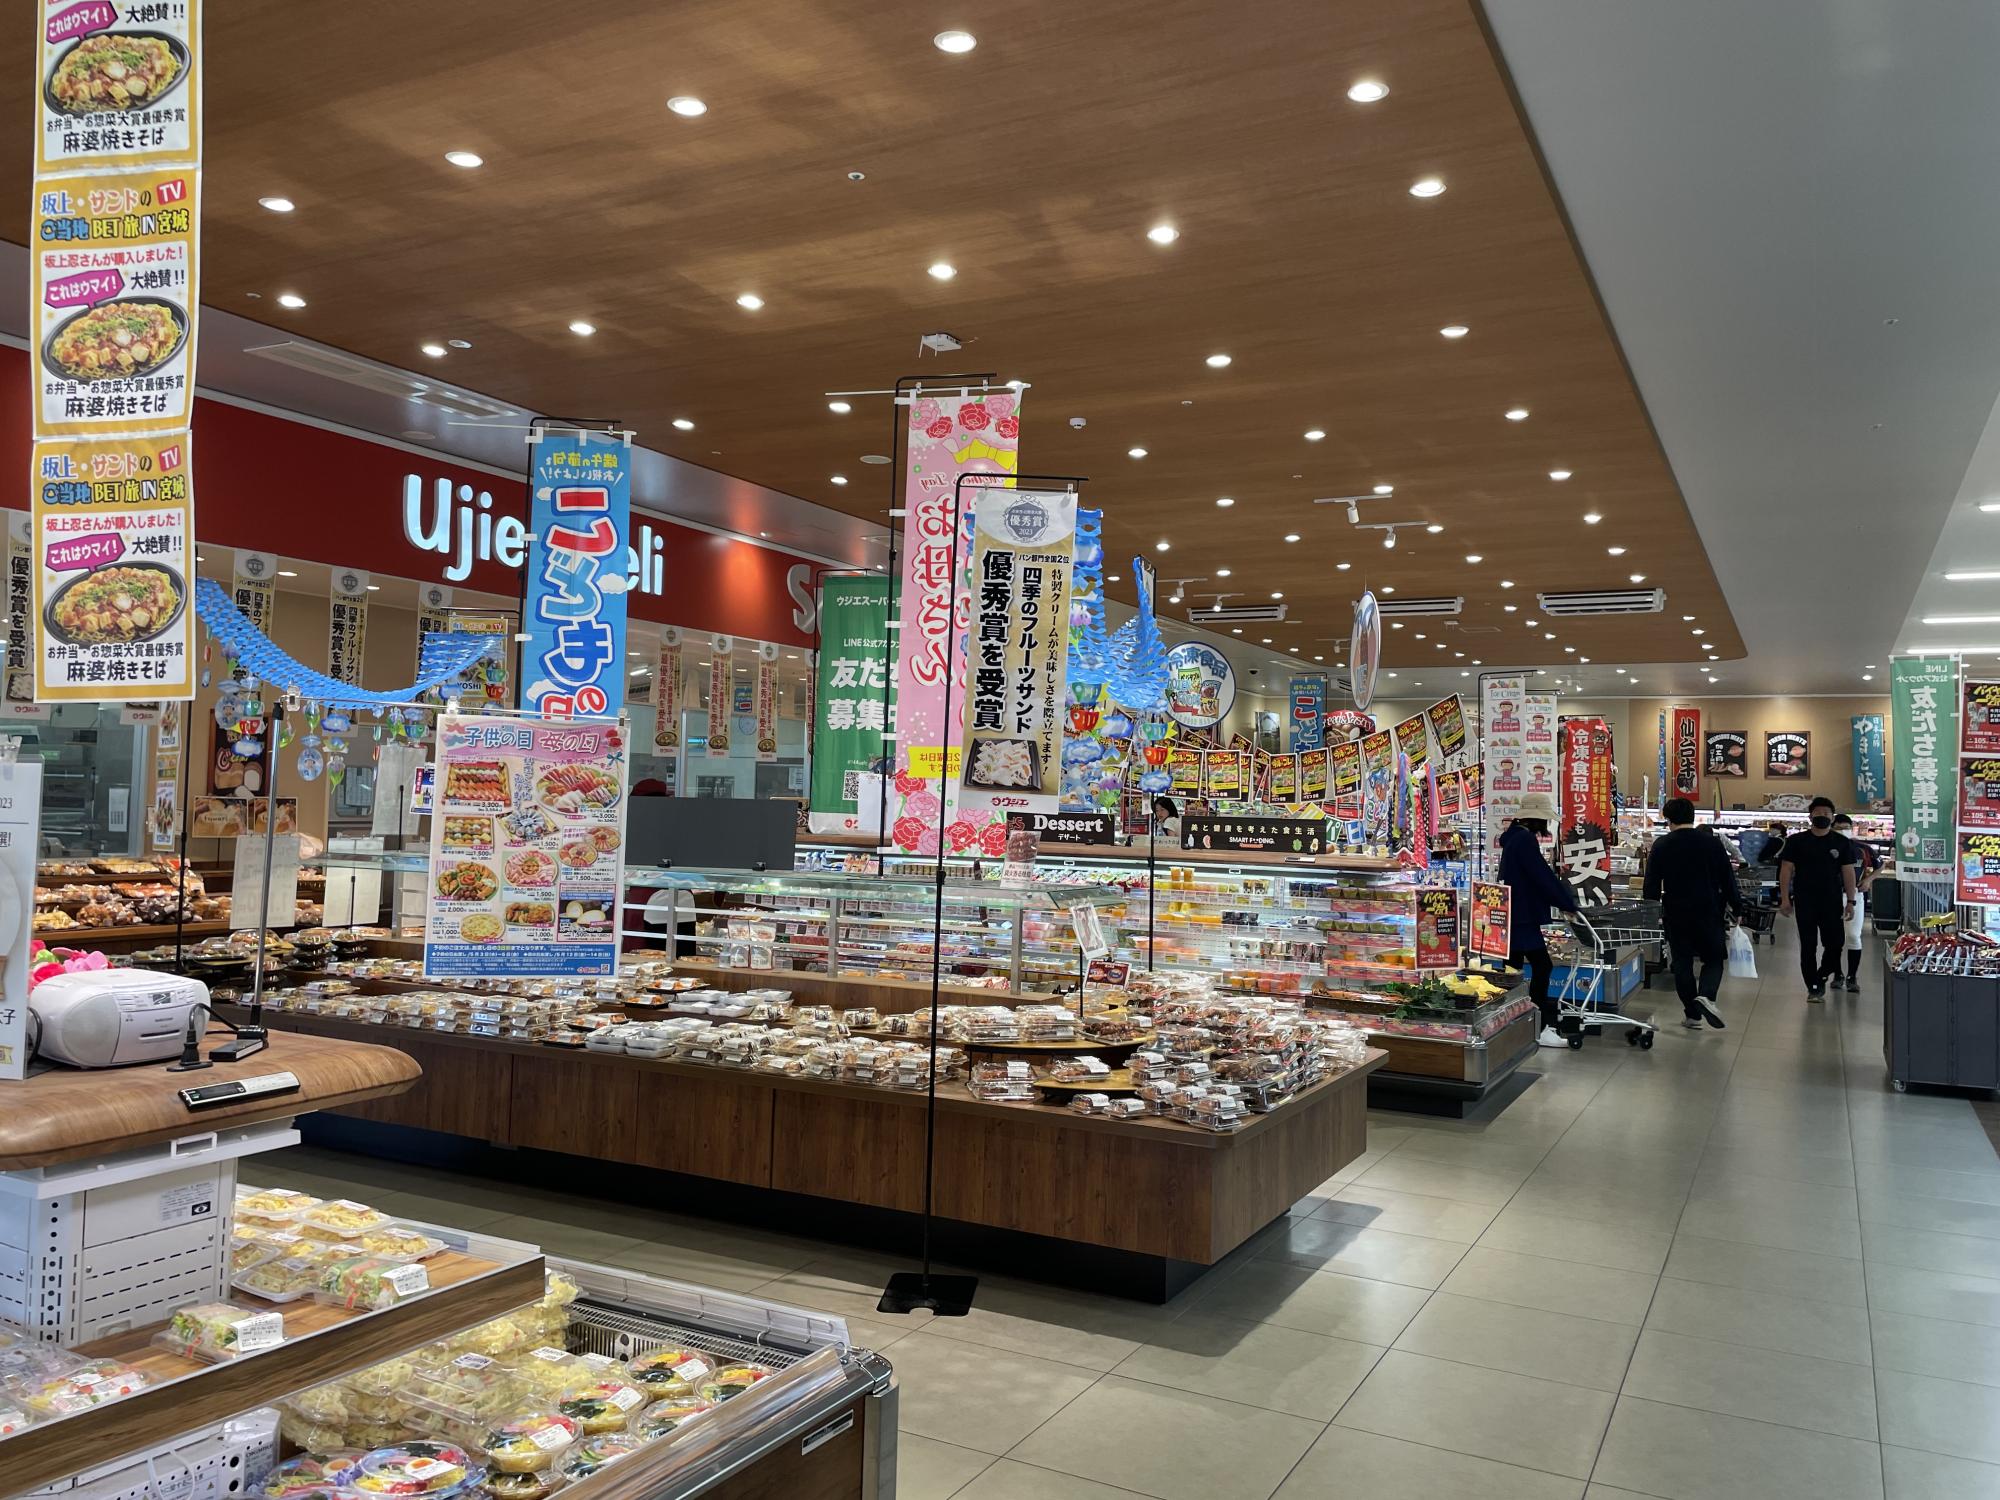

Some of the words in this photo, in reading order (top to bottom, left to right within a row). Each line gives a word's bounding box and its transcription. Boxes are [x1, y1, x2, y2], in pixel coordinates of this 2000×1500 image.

[63, 128, 165, 153] 麻婆焼きそば
[160, 181, 182, 203] TV
[65, 393, 168, 418] 麻婆焼きそば
[161, 449, 179, 470] TV
[403, 473, 527, 582] Ujie
[972, 549, 1014, 731] 優秀賞を受賞
[1015, 566, 1042, 734] 四季のフルーツサンド
[66, 659, 168, 682] 麻婆焼きそば
[1168, 646, 1228, 680] 冷凍食品
[464, 726, 534, 750] 子供の日
[540, 732, 599, 754] 母の日
[1786, 734, 1807, 746] MEATS
[1570, 728, 1590, 836] 冷凍食品いつでも
[1033, 814, 1104, 833] Dessert
[1190, 823, 1315, 836] 美と健康を考えた食生活
[1057, 833, 1081, 841] デザート
